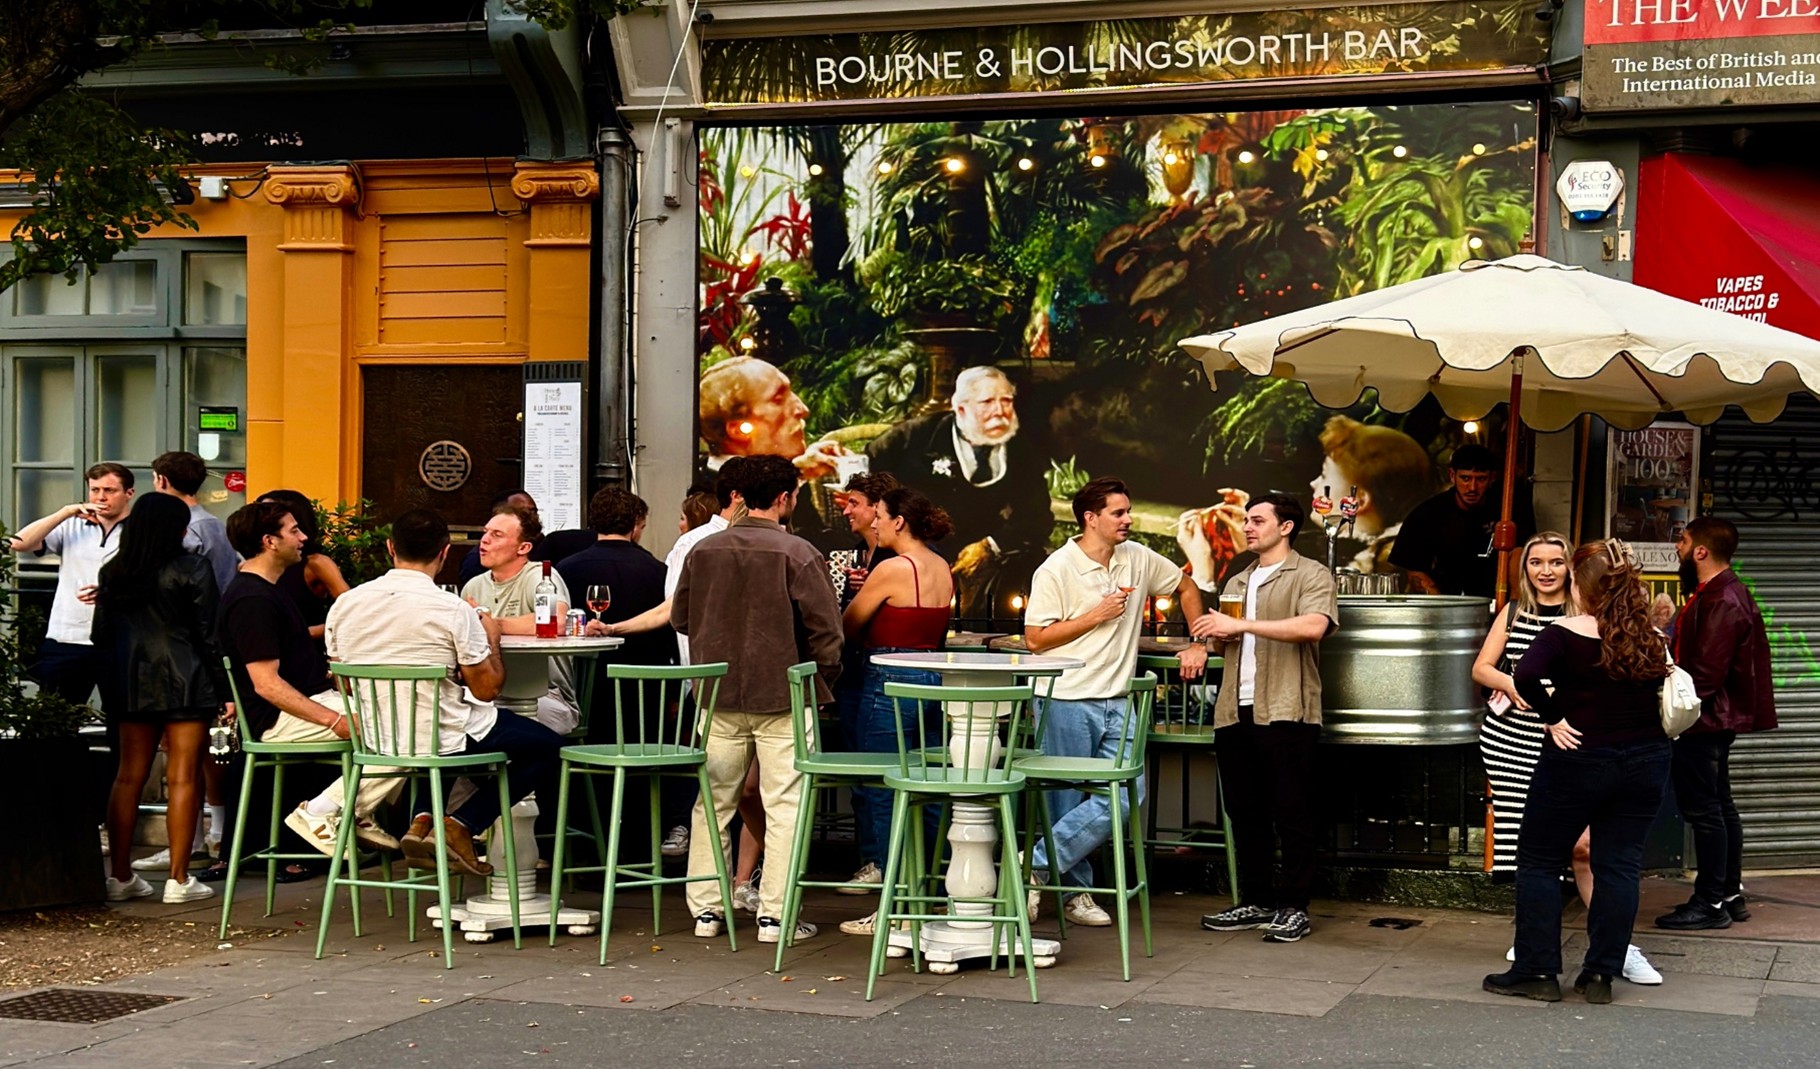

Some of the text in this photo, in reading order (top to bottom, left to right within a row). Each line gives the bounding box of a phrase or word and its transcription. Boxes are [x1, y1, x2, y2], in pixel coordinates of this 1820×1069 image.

[1607, 0, 1820, 26] THE WEE
[816, 27, 1422, 86] BOURNE & HOLLINGSWORTH BAR
[1611, 58, 1648, 74] The
[1652, 56, 1692, 72] Best
[1696, 54, 1718, 70] of
[1720, 51, 1786, 69] British
[1622, 70, 1816, 93] International Media
[1582, 170, 1612, 182] ECO
[1717, 275, 1764, 294] VAPES
[1700, 292, 1779, 312] TOBACCO &
[1619, 442, 1686, 457] GARDEN
[1634, 458, 1670, 480] 100
